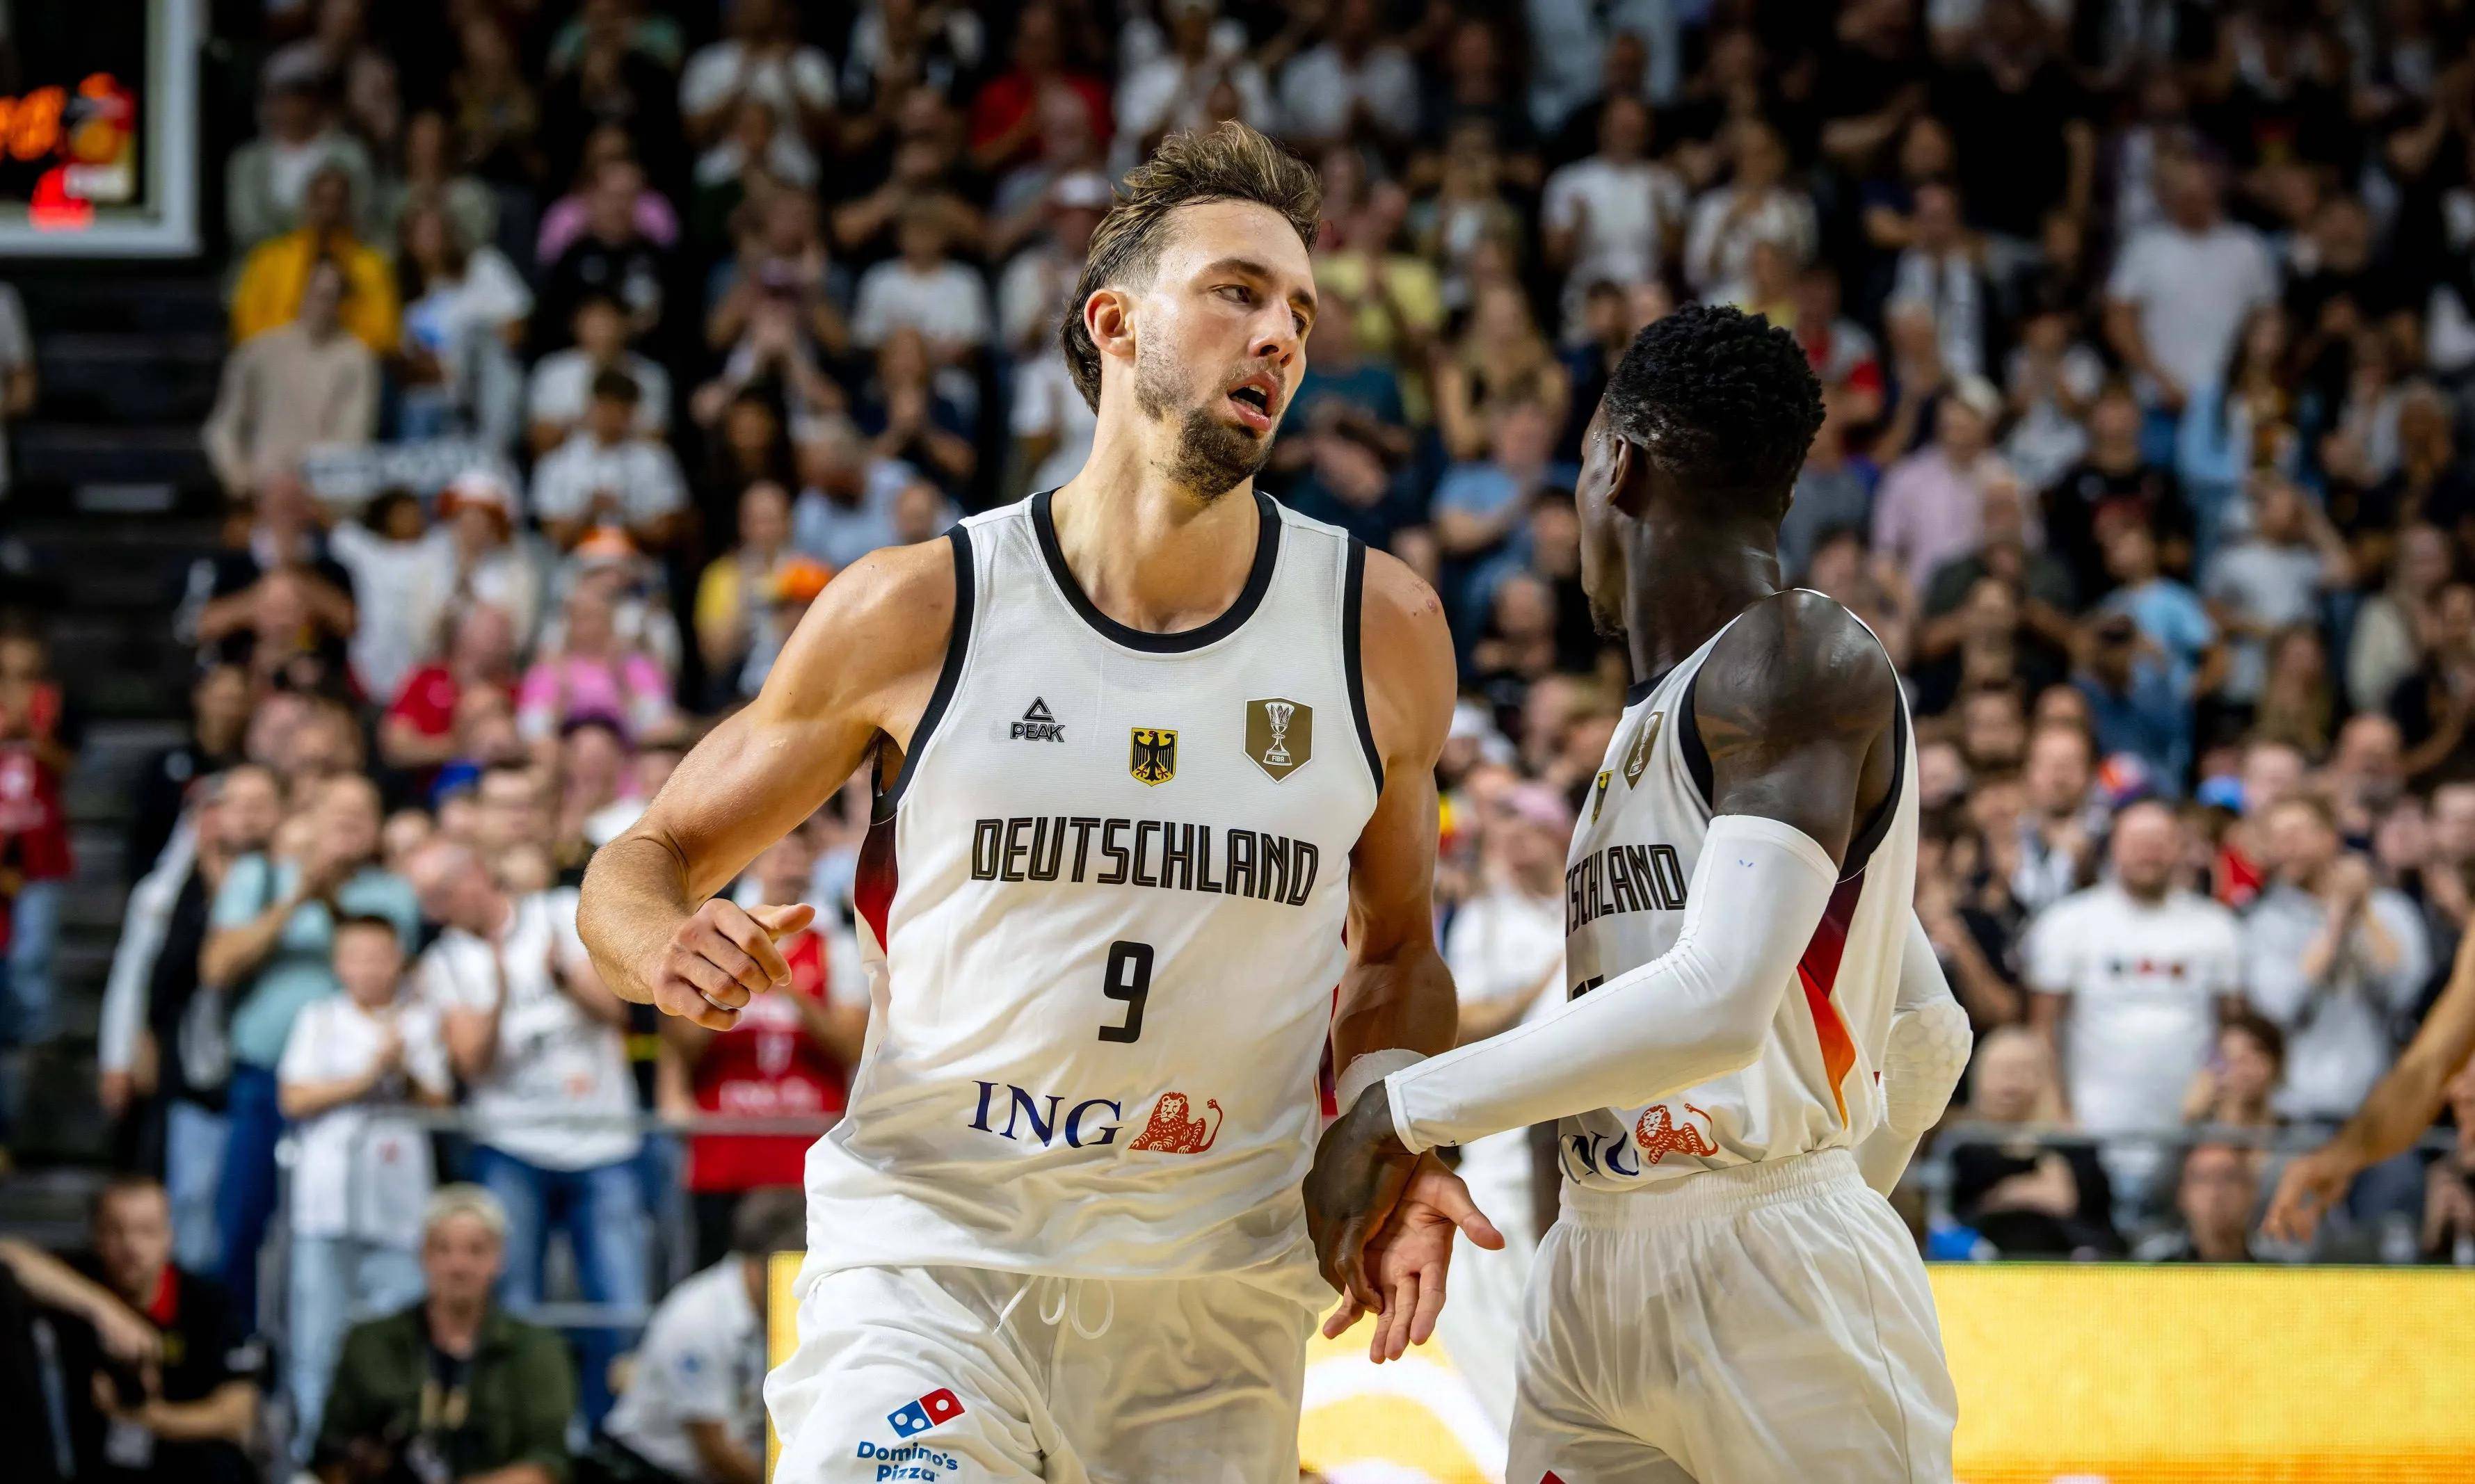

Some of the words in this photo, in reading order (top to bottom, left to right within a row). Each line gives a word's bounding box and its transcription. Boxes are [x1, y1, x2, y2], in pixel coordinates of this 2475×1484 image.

[1010, 722, 1066, 743] PEAK
[971, 816, 1319, 906] DEUTSCHLAND
[1098, 940, 1155, 1044] 9
[968, 1080, 1123, 1149] ING
[857, 1441, 958, 1470] Domino's
[876, 1464, 935, 1483] Pizza
